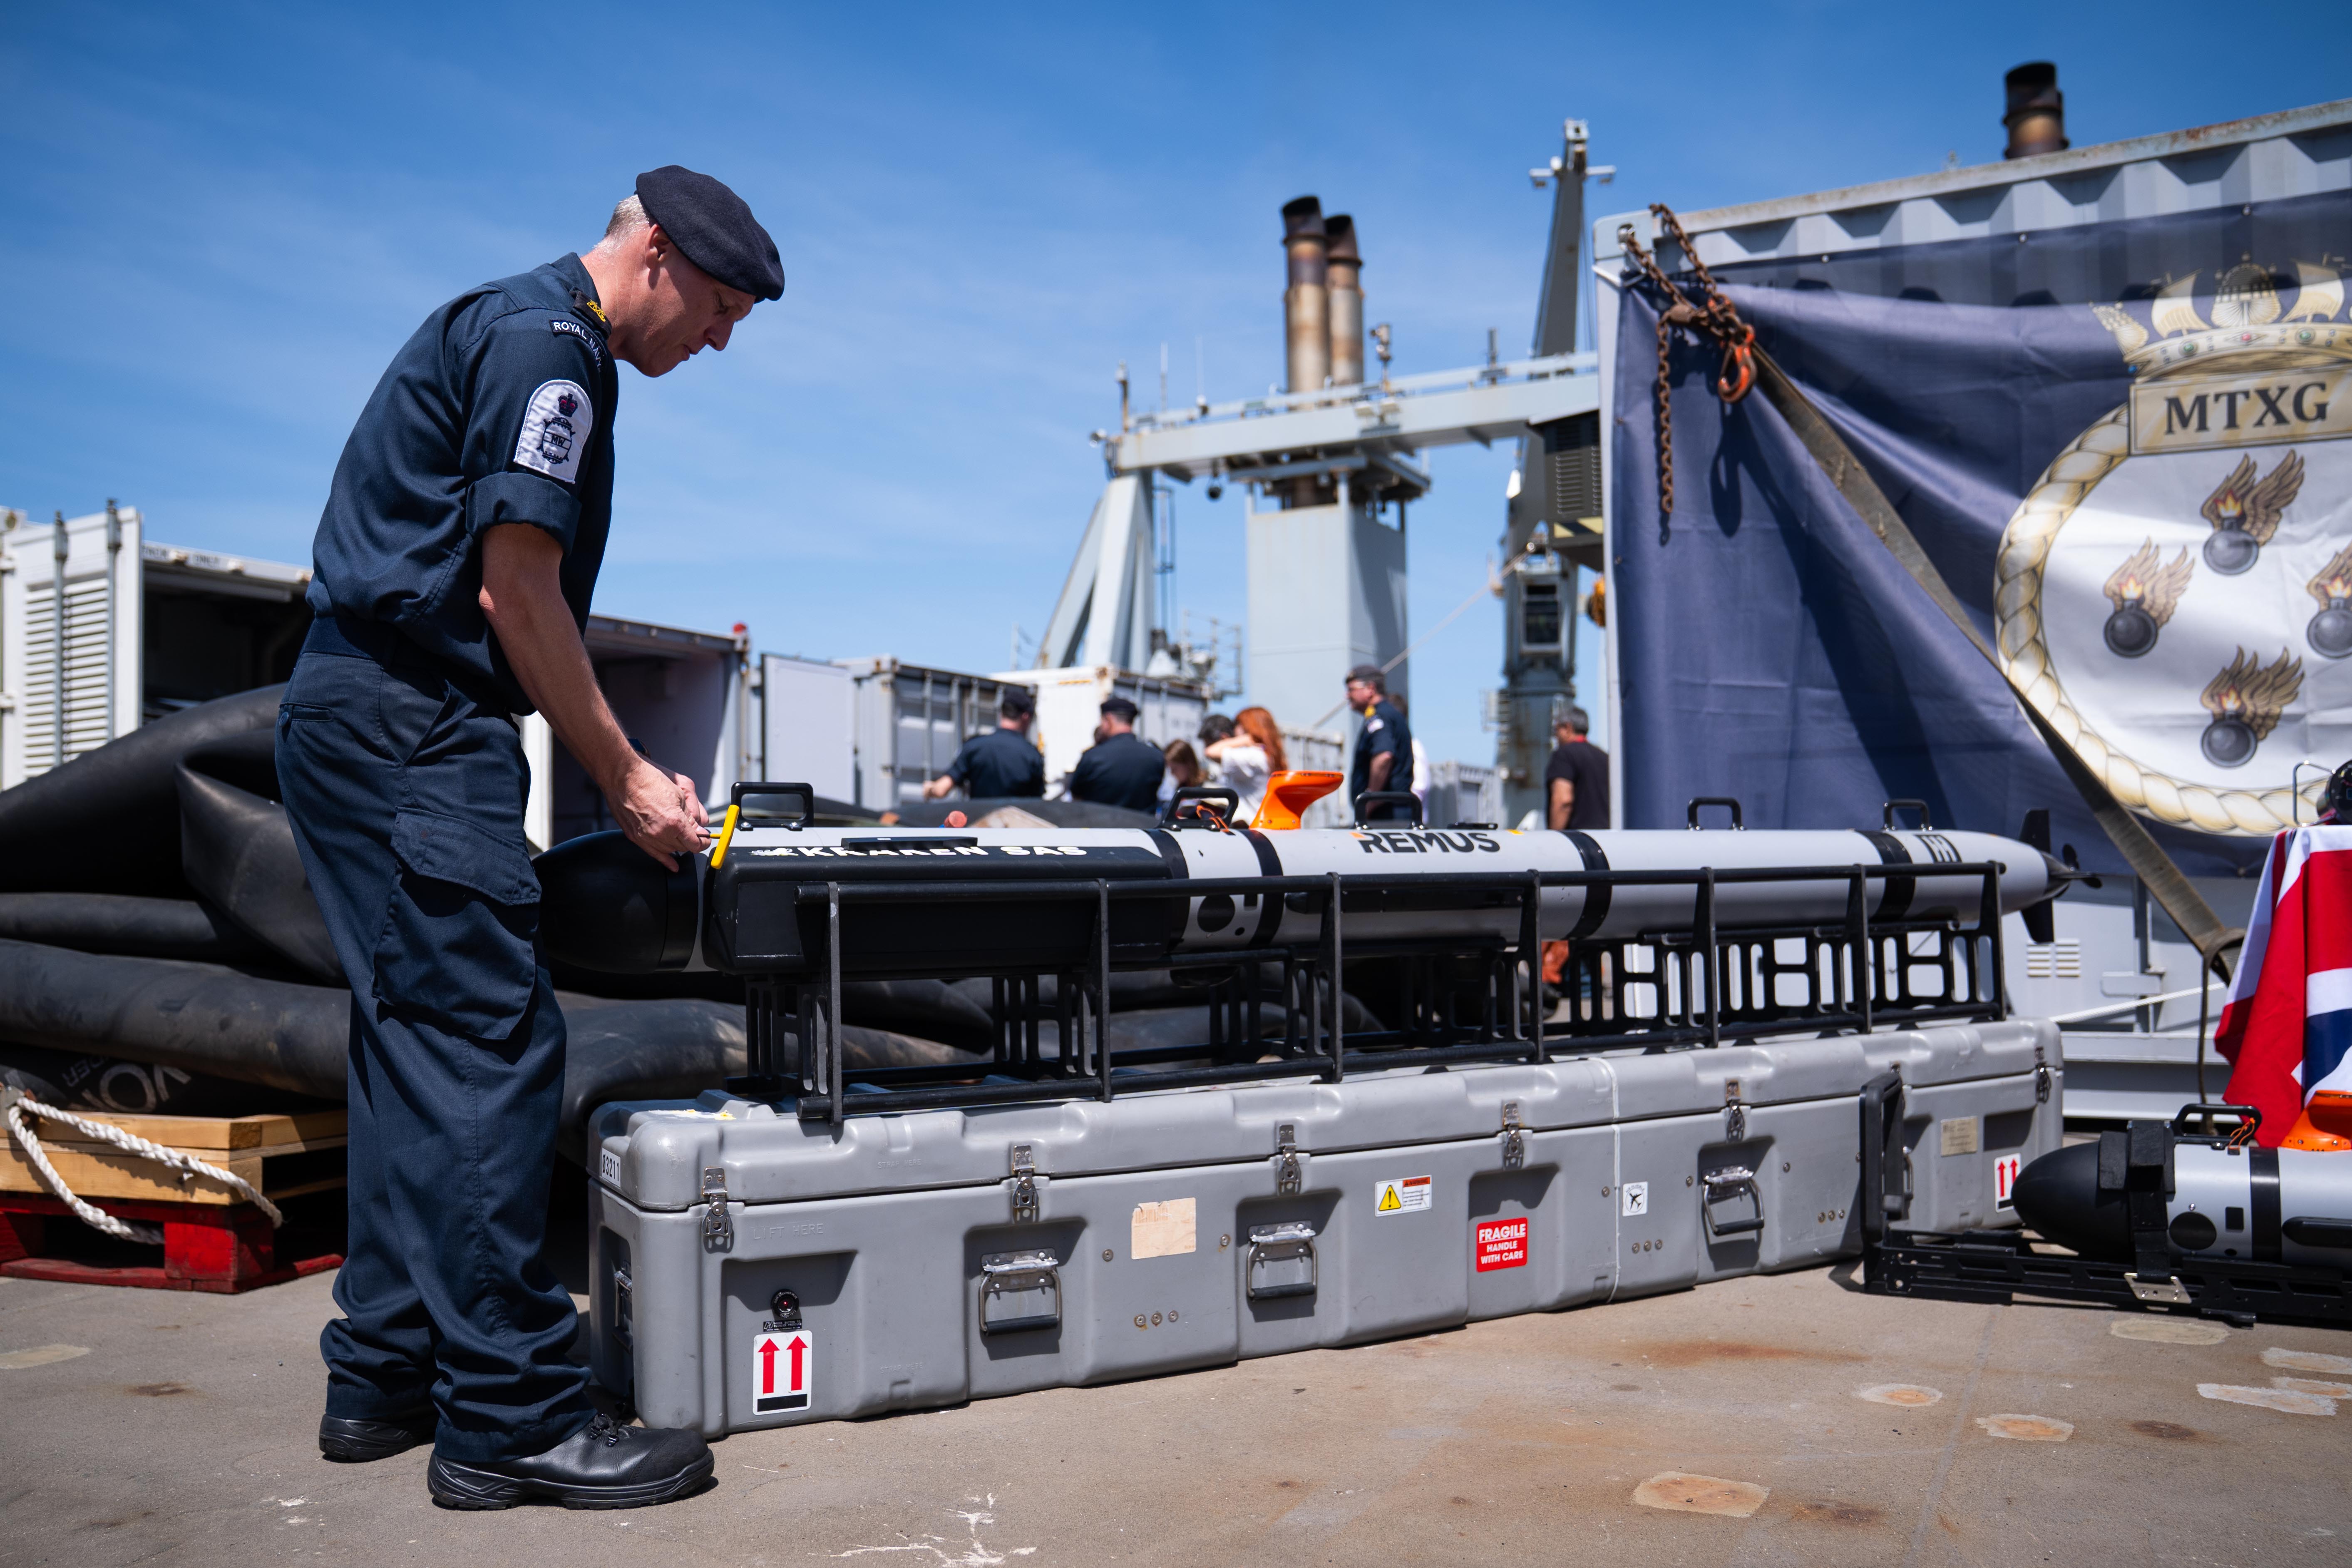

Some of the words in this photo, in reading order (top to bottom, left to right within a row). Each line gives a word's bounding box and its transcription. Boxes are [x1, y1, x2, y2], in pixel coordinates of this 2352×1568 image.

[553, 322, 587, 339] ROYAL
[589, 338, 601, 367] NAVY
[2165, 382, 2330, 435] MTXG
[551, 435, 566, 447] MW
[797, 846, 989, 856] KRAKEN
[1001, 846, 1087, 856] SAS
[1350, 832, 1500, 853] REMUS
[753, 1227, 785, 1240] LIFT
[793, 1223, 824, 1236] HERE
[1478, 1223, 1526, 1241] FRAGILE
[1486, 1240, 1518, 1252] HANDLE
[1480, 1253, 1501, 1264] WITH
[1502, 1250, 1524, 1261] CARE
